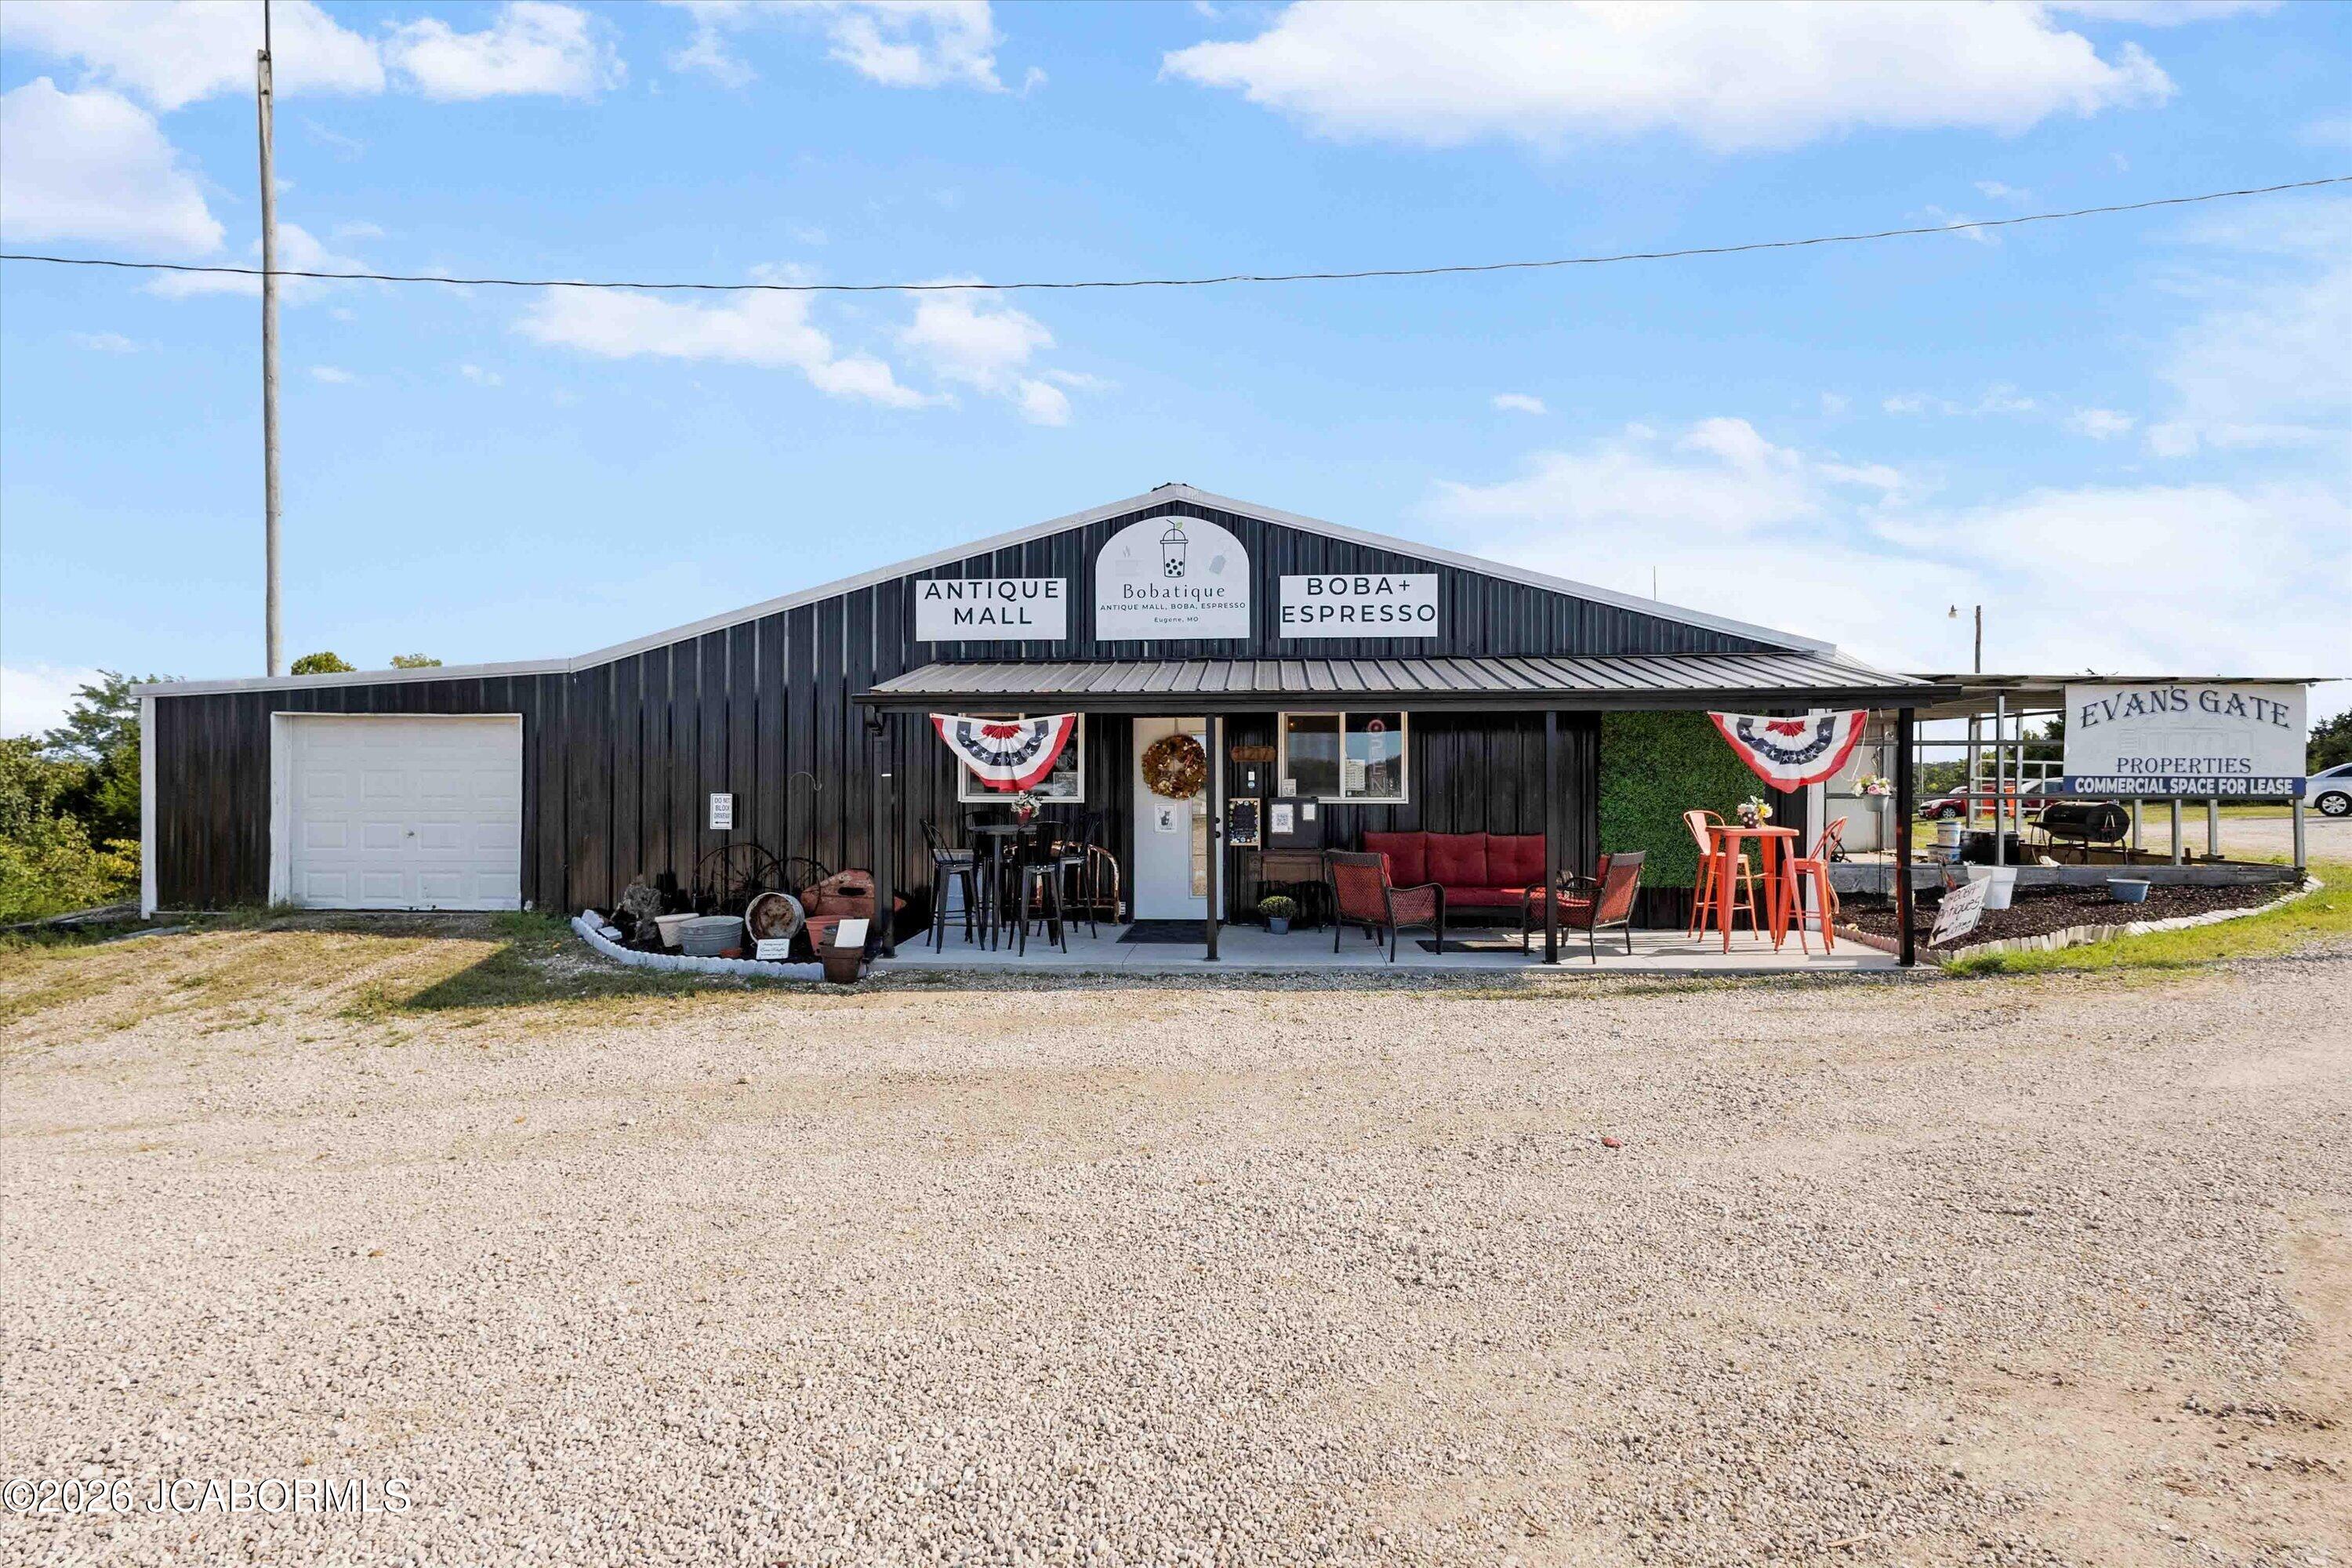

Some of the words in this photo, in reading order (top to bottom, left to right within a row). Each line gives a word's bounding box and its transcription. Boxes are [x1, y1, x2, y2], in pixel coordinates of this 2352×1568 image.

[924, 581, 1058, 602] ANTIQUE
[1123, 583, 1225, 602] Bobatique
[1307, 577, 1410, 595] BOBA+
[954, 607, 1032, 625] MALL
[1282, 604, 1436, 622] ESPRESSO
[2081, 685, 2188, 728] EVAN'S
[2199, 690, 2290, 729] GATE
[2117, 757, 2252, 775] PROPERTIES
[2074, 777, 2166, 794] COMMERCIAL
[2169, 778, 2216, 794] SPACE
[2219, 777, 2247, 794] FOR
[2250, 777, 2292, 794] LEASE
